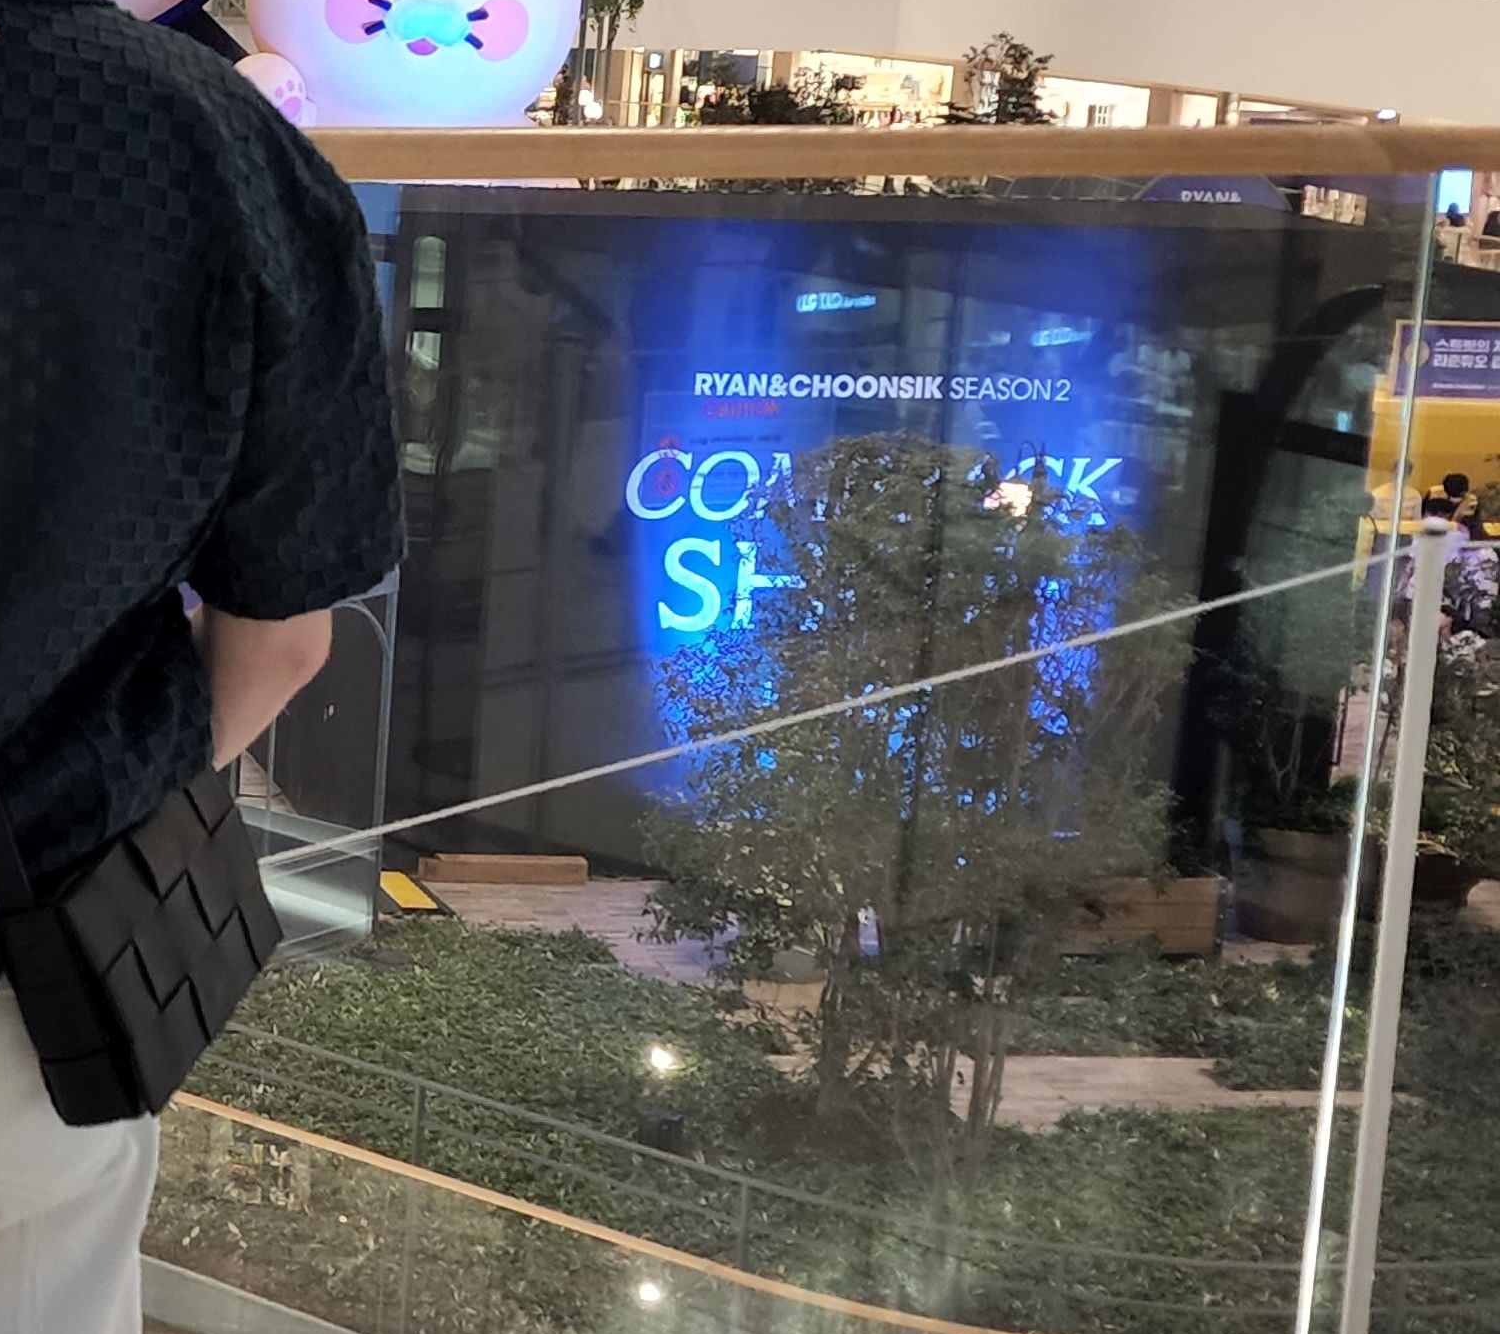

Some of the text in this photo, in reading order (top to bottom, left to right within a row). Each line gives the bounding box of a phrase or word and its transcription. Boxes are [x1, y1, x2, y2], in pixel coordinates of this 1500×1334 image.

[694, 372, 1072, 402] RYAN&CHOONSIK SEASON 2
